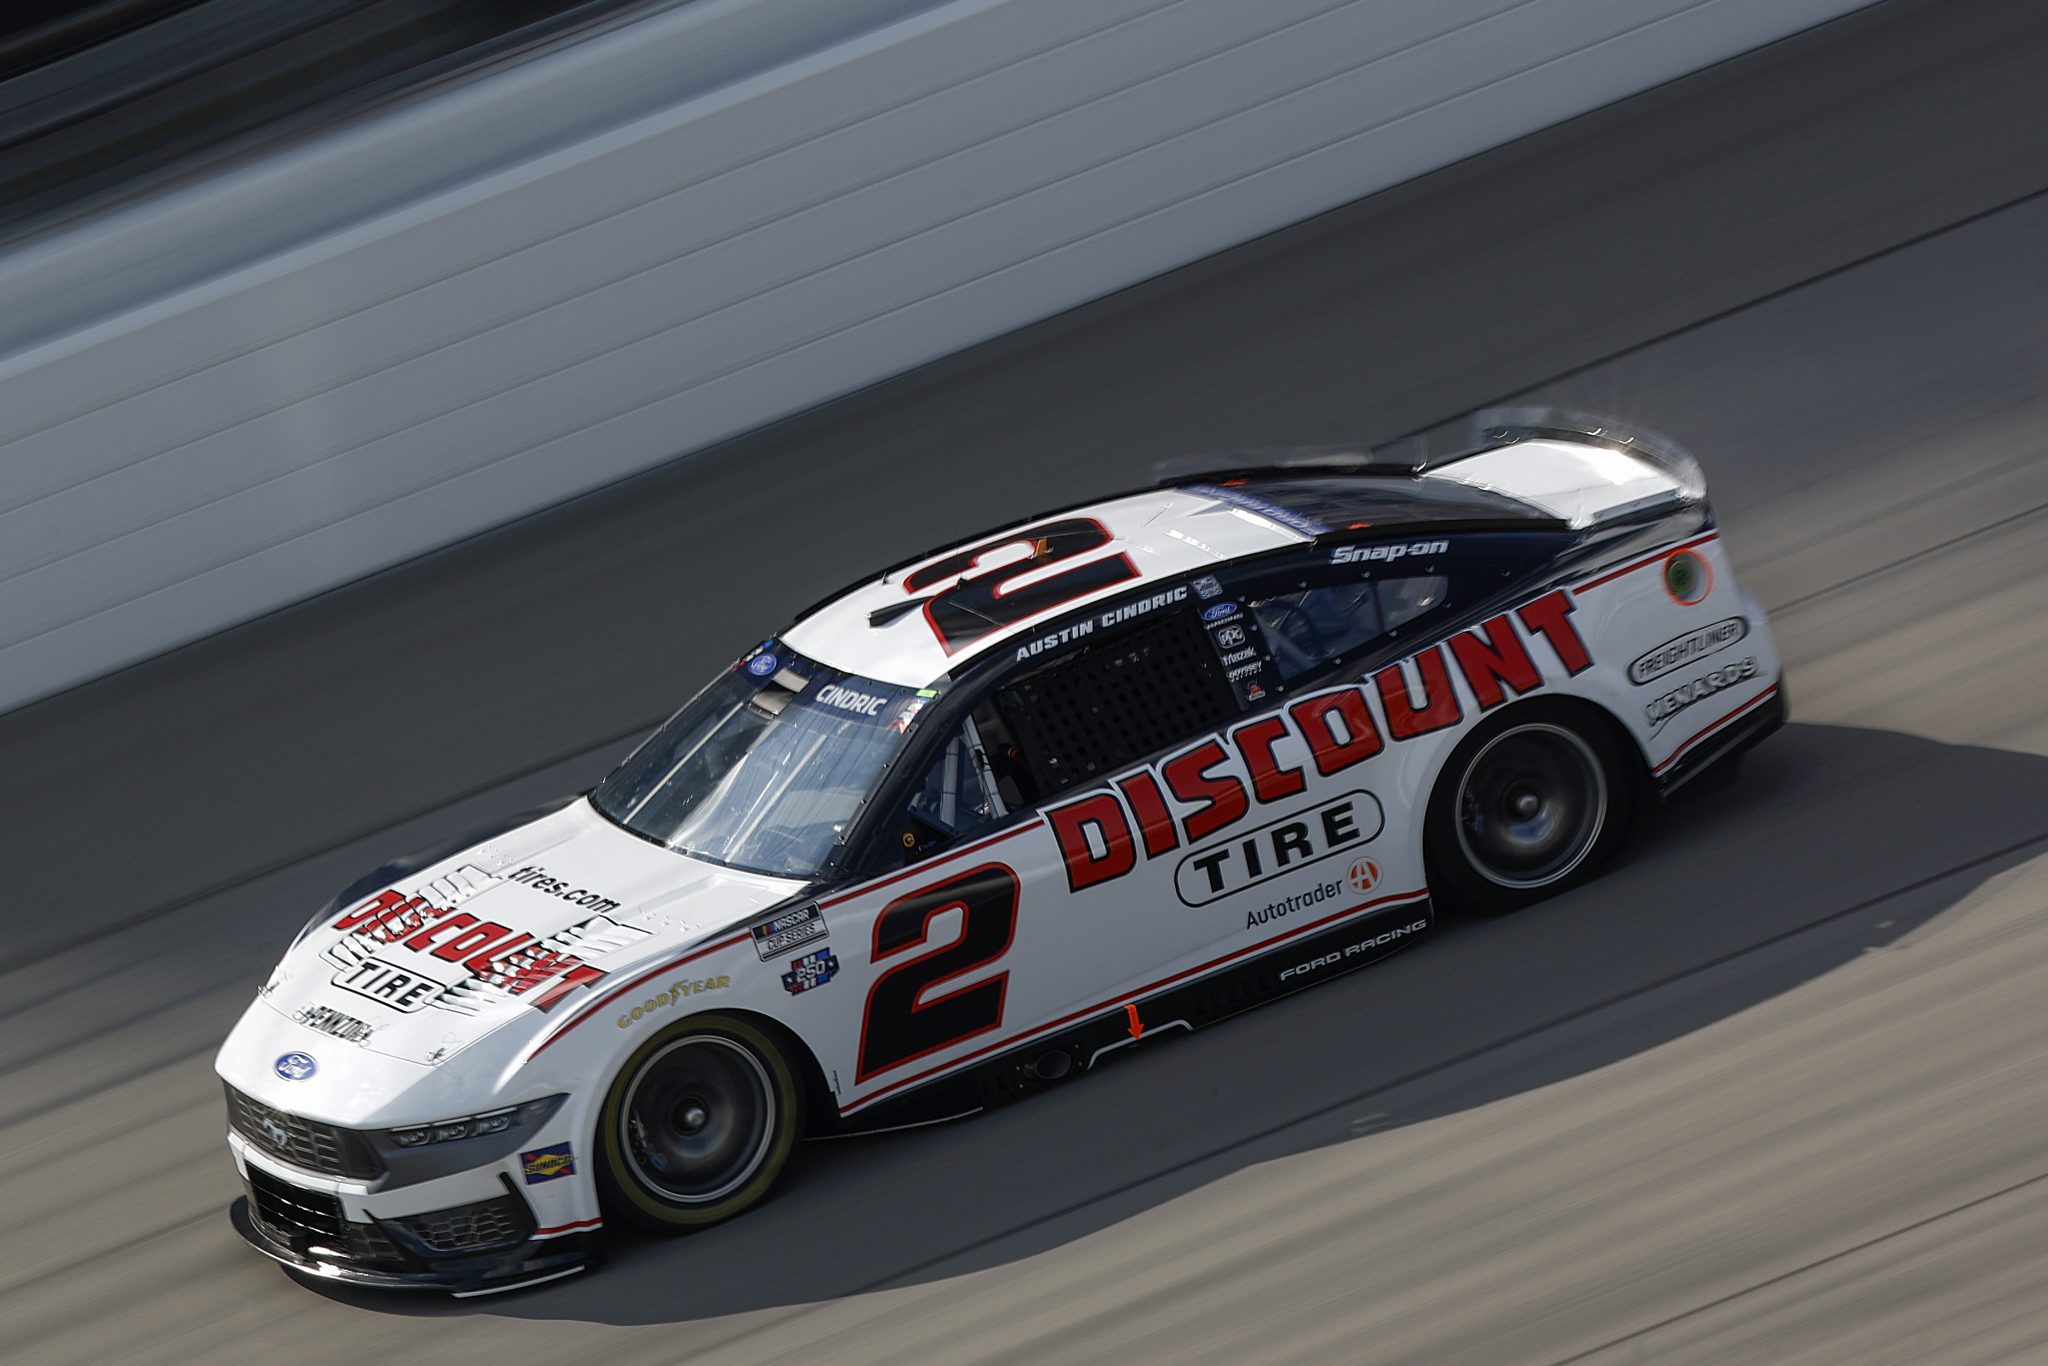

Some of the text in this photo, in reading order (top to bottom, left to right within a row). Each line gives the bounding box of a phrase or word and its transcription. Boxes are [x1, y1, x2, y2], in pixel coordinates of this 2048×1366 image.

[1330, 540, 1449, 564] Snap-on
[1015, 619, 1094, 663] AUSTIN
[1102, 585, 1188, 628] CINDRIC
[1638, 622, 1740, 680] FREIGHTLINER
[815, 683, 888, 716] CINDRIC
[1045, 589, 1595, 893] DISCOUNT
[1193, 800, 1361, 894] TIRE
[507, 865, 622, 914] tires.com
[1246, 877, 1344, 930] Autotrader
[767, 924, 816, 950] CUP SERIES
[774, 909, 809, 932] NASCAR
[797, 959, 826, 983] 250
[855, 861, 1022, 1086] 2
[1280, 918, 1428, 981] FORD RACING
[344, 961, 438, 1008] TIRE
[617, 975, 731, 1029] GOODYEAR
